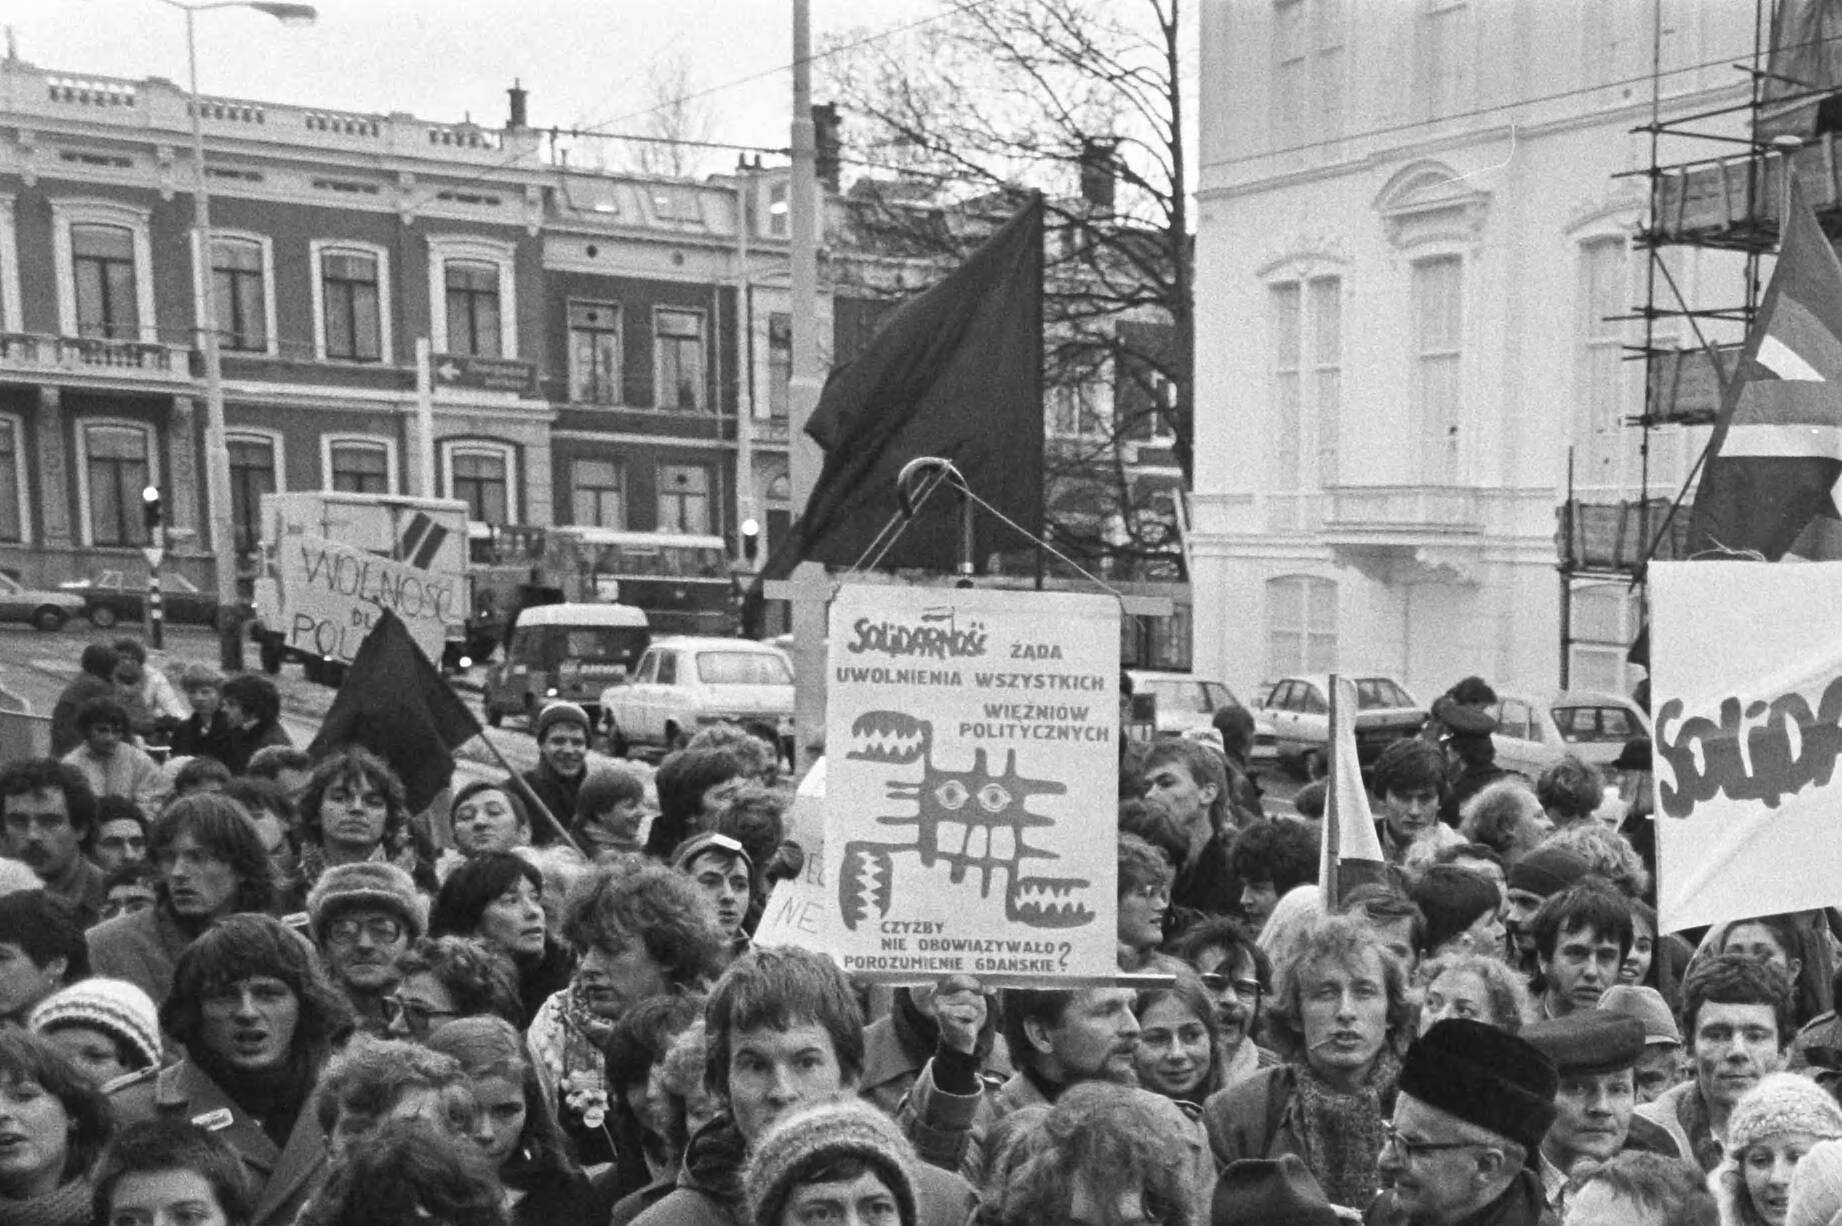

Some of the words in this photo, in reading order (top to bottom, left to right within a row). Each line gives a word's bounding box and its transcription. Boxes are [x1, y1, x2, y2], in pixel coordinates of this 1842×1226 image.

[1009, 640, 1063, 662] ŻĄDA
[836, 667, 962, 687] UWOLNIENIA
[975, 672, 1105, 692] WSZYSTKICH
[958, 723, 1110, 743] POLITYCZNYCH
[880, 937, 907, 952] NIE
[844, 955, 964, 971] POROZUMIENIE
